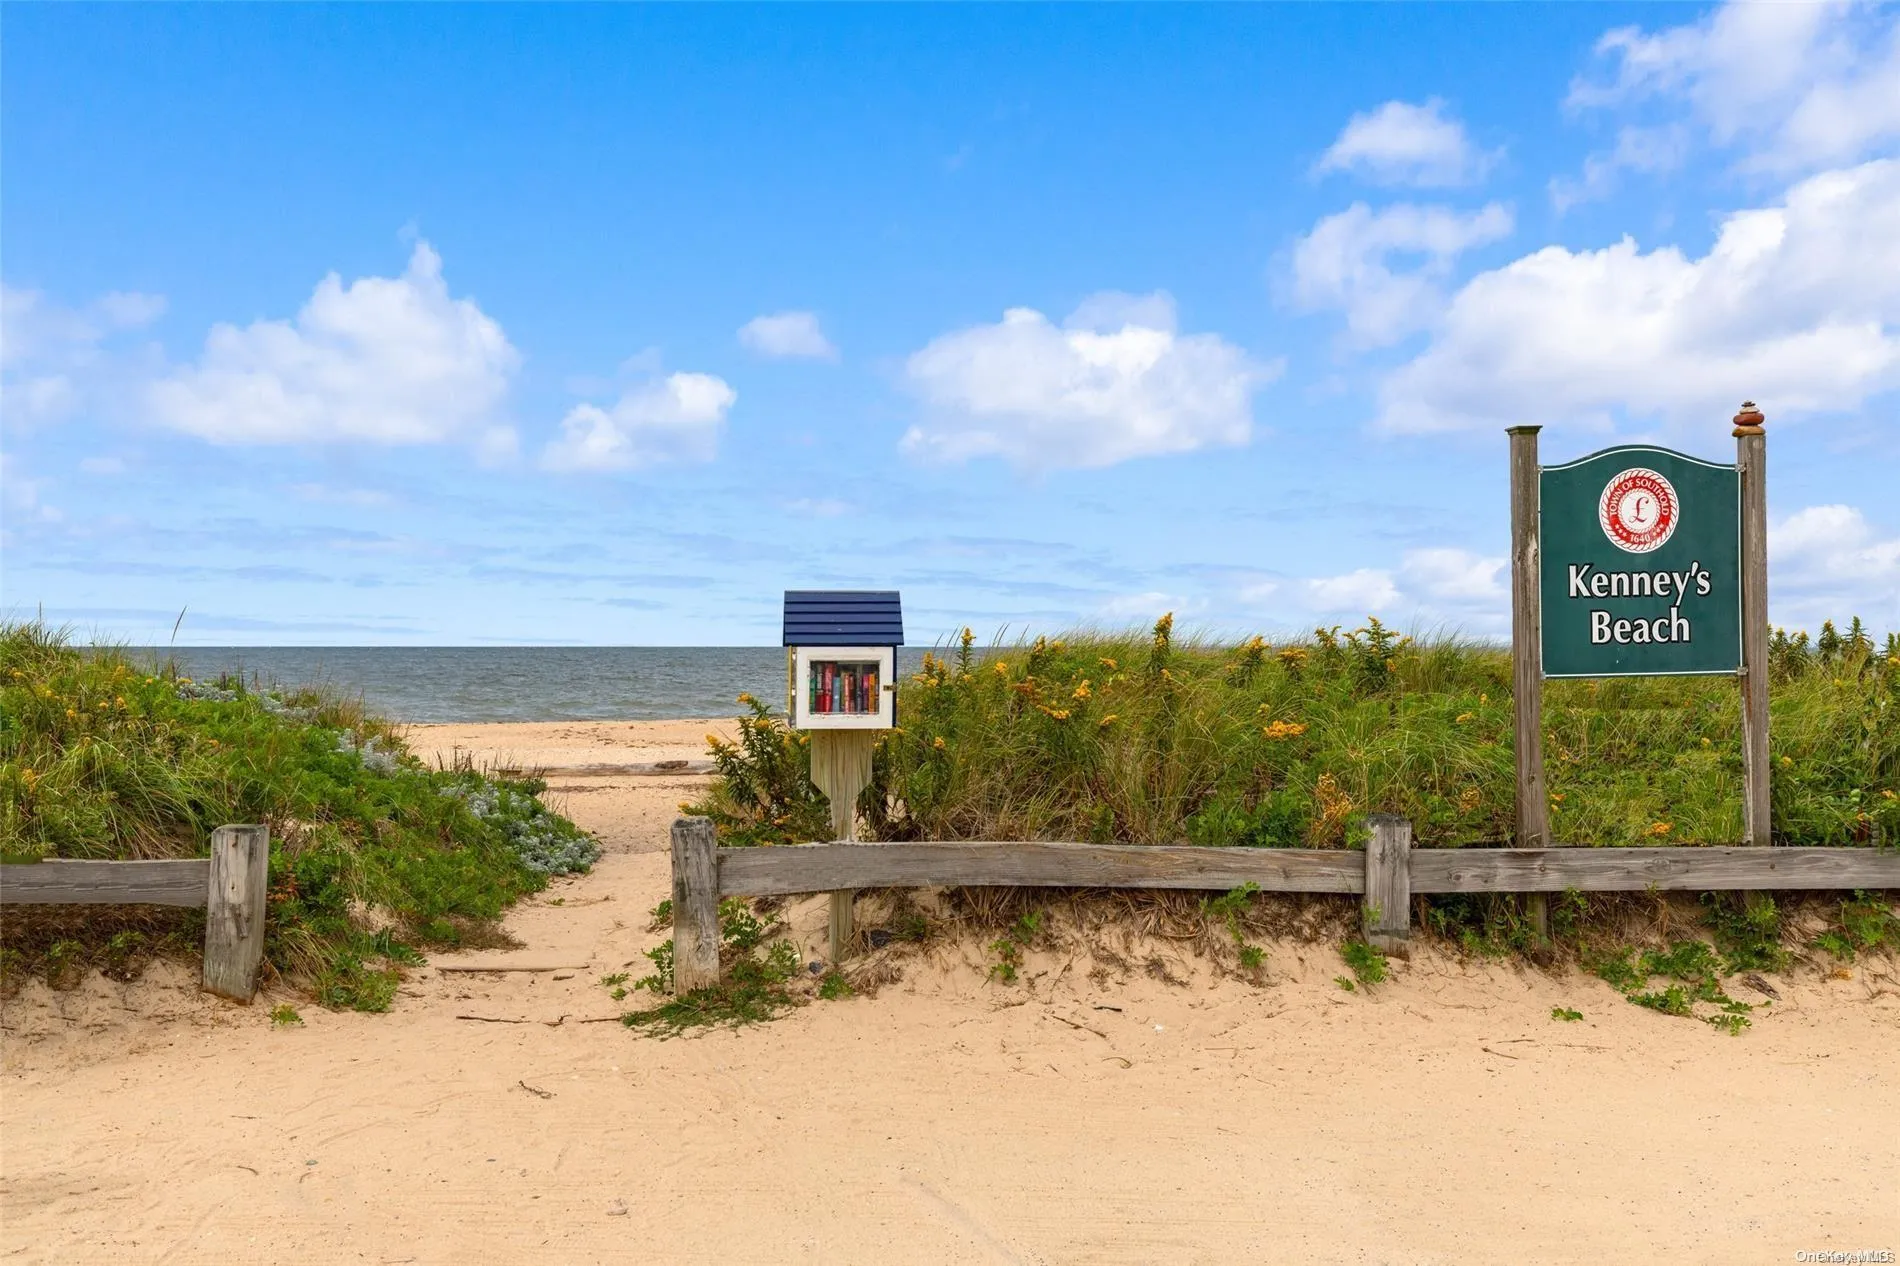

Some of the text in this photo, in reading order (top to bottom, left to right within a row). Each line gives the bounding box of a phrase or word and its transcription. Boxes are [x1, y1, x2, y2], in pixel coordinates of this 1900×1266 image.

[1609, 478, 1670, 516] TOWN OF SOUTHOLD
[1630, 533, 1651, 543] 1640
[1568, 561, 1711, 606] Kenney's
[1590, 606, 1690, 643] Beach
